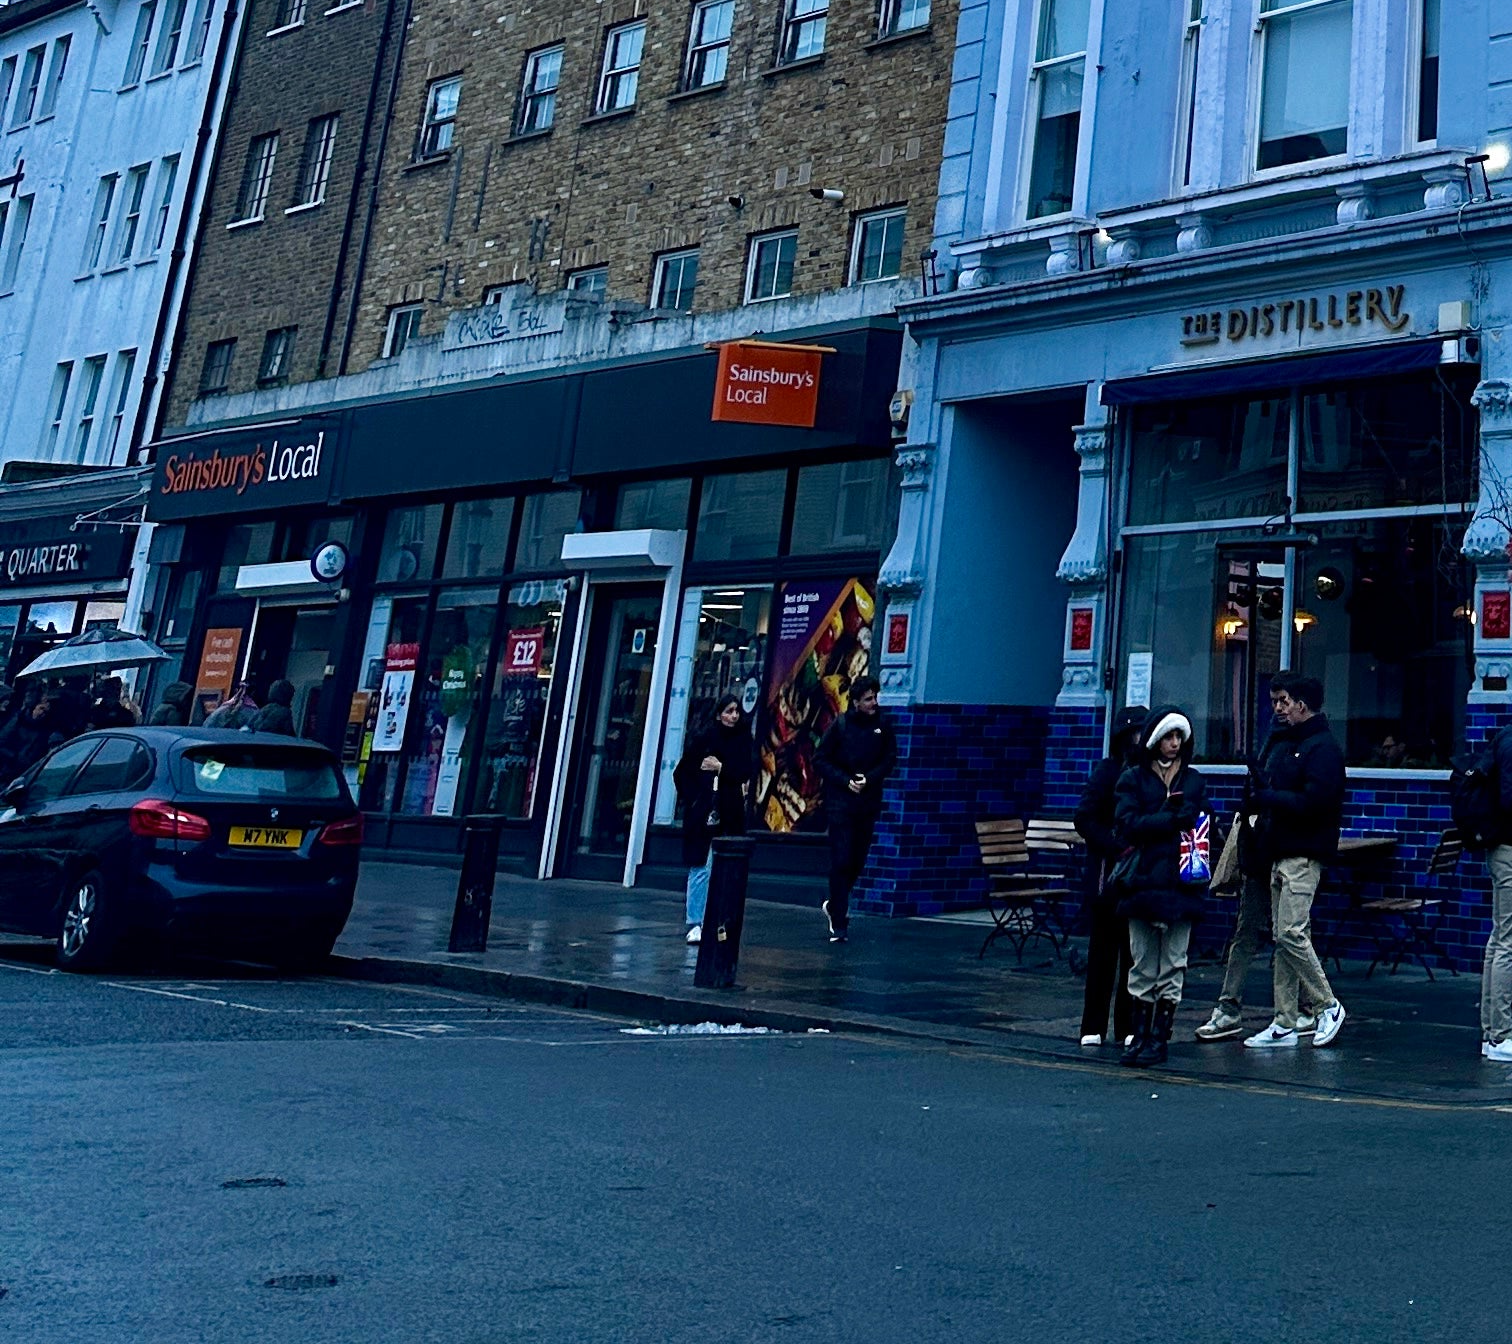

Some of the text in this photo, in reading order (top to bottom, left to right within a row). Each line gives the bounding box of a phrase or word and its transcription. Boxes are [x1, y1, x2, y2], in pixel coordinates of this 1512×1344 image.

[1180, 284, 1410, 340] THE DISTILLERY
[729, 363, 815, 390] Sainsbury's
[726, 384, 768, 405] Local
[161, 431, 325, 495] Sainsbury's Local
[7, 543, 81, 582] QUARTER
[513, 640, 536, 665] £12
